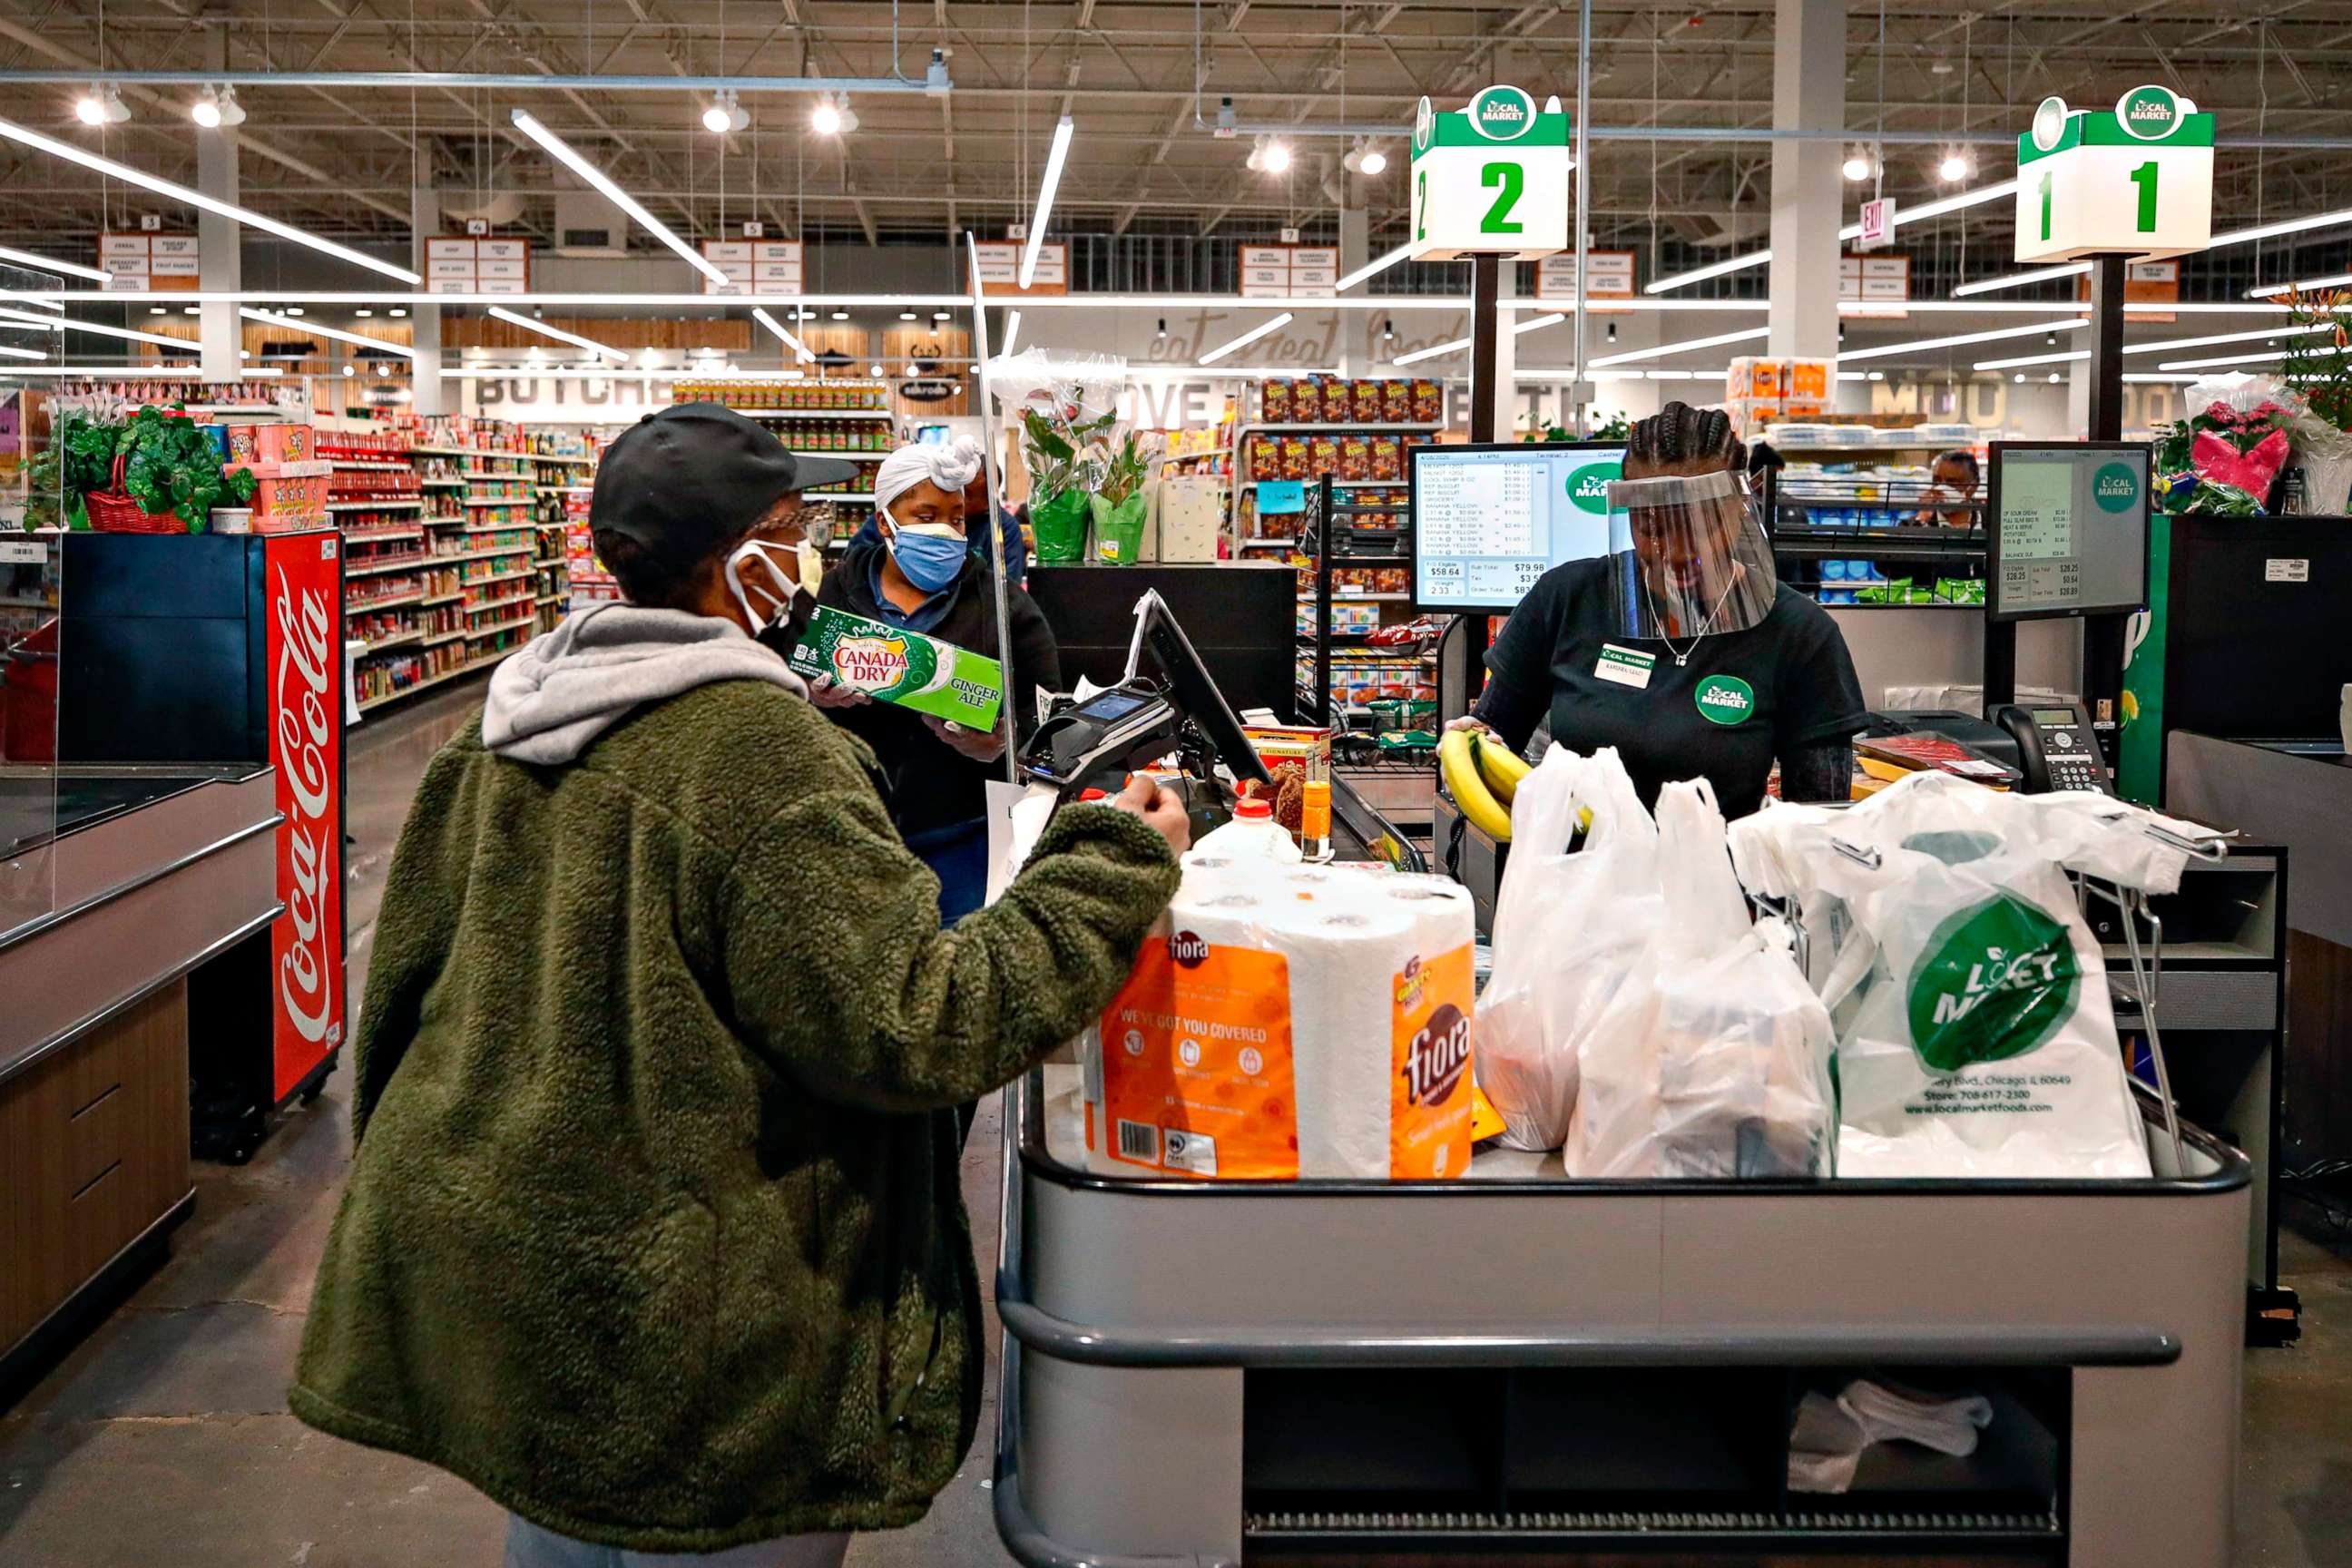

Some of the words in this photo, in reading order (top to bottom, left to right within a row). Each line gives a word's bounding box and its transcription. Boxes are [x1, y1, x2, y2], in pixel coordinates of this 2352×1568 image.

[1486, 103, 1519, 113] LOCAL
[2134, 102, 2167, 112] LOCAL
[1482, 112, 1524, 121] MARKET
[2131, 111, 2171, 120] MARKET
[1481, 162, 1524, 233] 2
[2131, 162, 2159, 232] 1
[1418, 171, 1426, 241] 2
[2038, 172, 2052, 241] 1
[1866, 201, 1882, 231] EXIT
[750, 225, 757, 234] 5
[1287, 230, 1294, 240] 7
[1149, 313, 1228, 361] eat
[1122, 382, 1210, 430] OVE
[2102, 478, 2131, 487] LOCAL
[2098, 487, 2135, 496] MARKET
[1431, 567, 1460, 575] $58.64
[1514, 563, 1544, 572] $79.98
[1520, 574, 1540, 583] $3.5
[2006, 572, 2026, 581] $28.25
[1431, 586, 1450, 595] 2.33
[1514, 585, 1531, 594] $83
[833, 646, 908, 668] CANADA
[1602, 650, 1623, 661] LOCAL
[1624, 656, 1652, 667] MARKET
[853, 666, 889, 681] DRY
[950, 677, 999, 701] GINGER
[1708, 688, 1745, 701] LOCAL
[958, 692, 985, 709] ALE
[1700, 695, 1749, 710] MARKET
[276, 561, 330, 1044] Coca-Cola
[1168, 934, 1210, 960] fiora
[1156, 1014, 1181, 1031] GOT
[1183, 1017, 1208, 1036] YOU
[1210, 1022, 1267, 1044] COVERED
[1406, 1016, 1471, 1098] fiora
[1904, 1104, 2053, 1116] www.localmarketfoods.com
